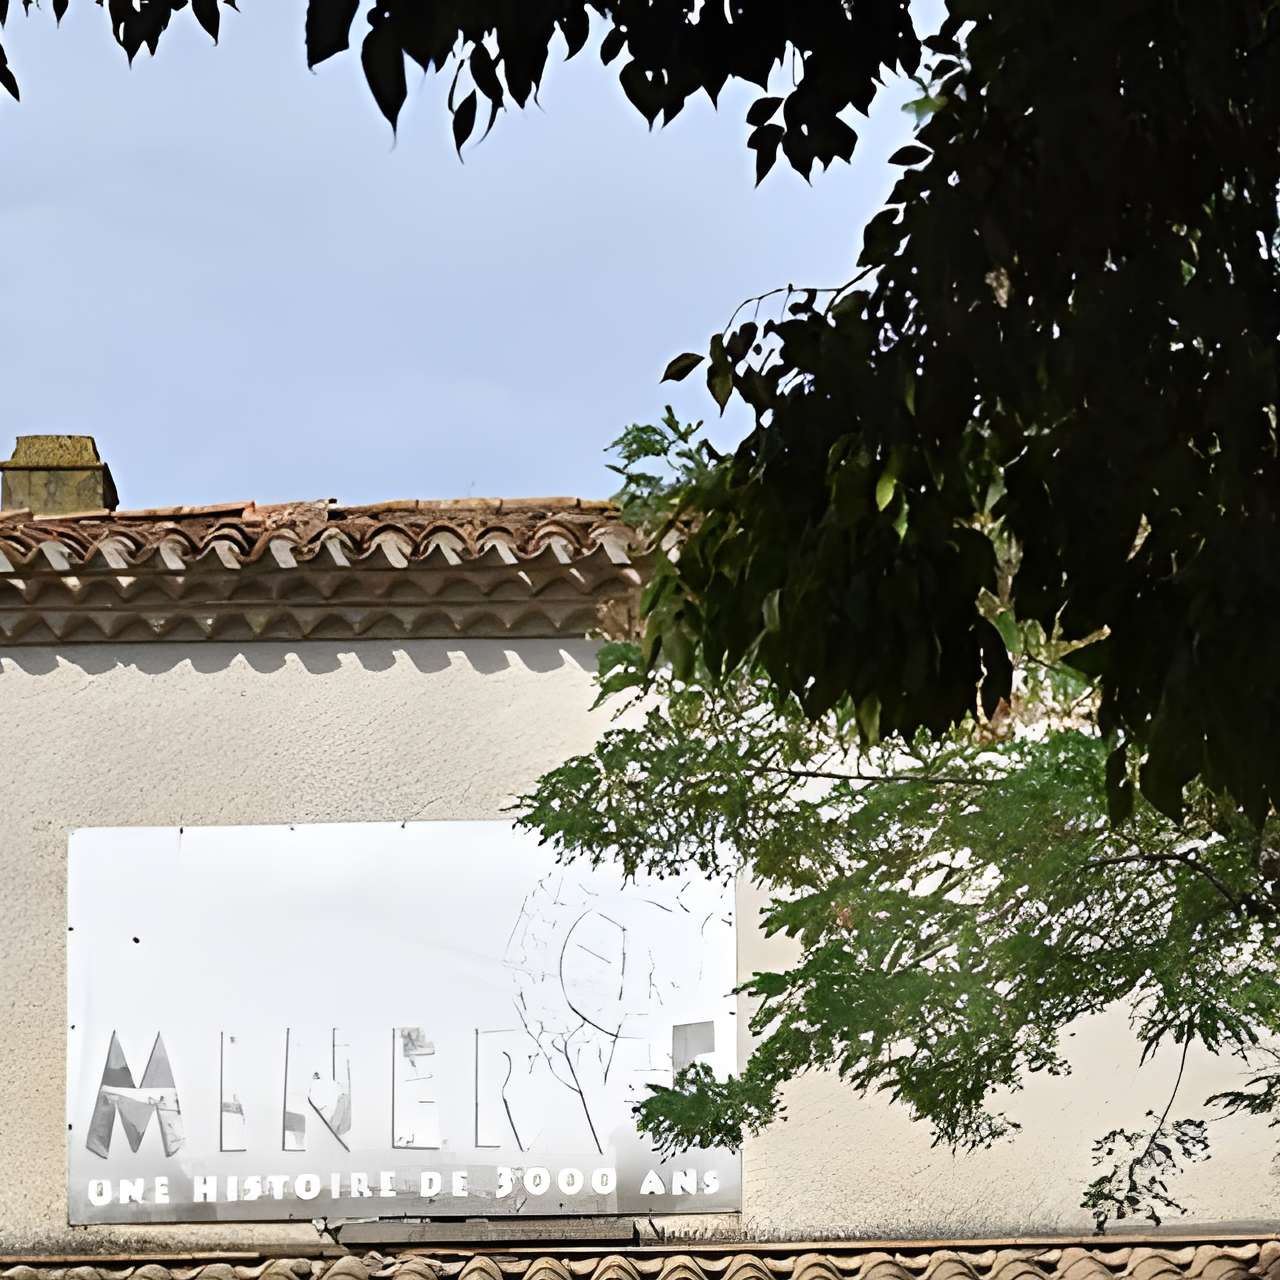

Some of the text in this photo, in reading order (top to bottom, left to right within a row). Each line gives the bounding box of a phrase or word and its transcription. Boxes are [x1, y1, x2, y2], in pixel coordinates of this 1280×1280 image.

[193, 1170, 397, 1203] HISTOIRE
[420, 1171, 469, 1198] DE
[639, 1168, 721, 1197] ANS
